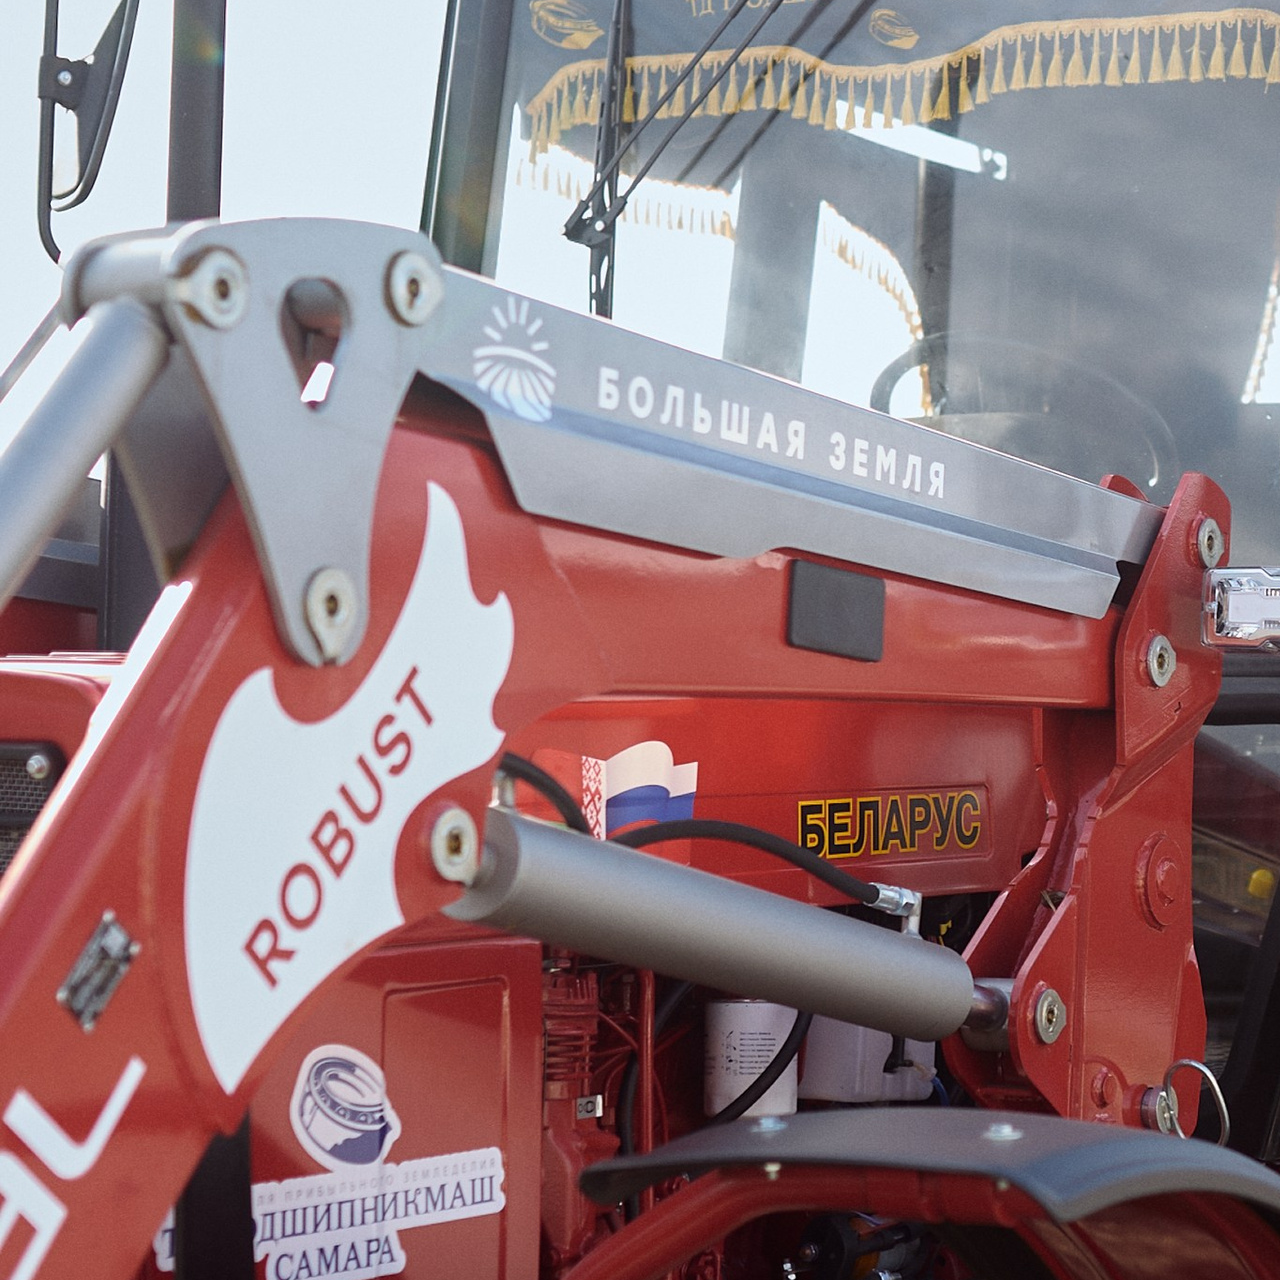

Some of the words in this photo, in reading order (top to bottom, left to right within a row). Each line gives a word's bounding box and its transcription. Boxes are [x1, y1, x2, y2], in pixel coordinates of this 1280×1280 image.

[598, 366, 806, 460] БОЛЬШАЯ
[828, 432, 946, 499] ЗЕМЛЯ
[242, 665, 434, 989] ROBUST
[798, 790, 981, 859] БЕЛАРУС
